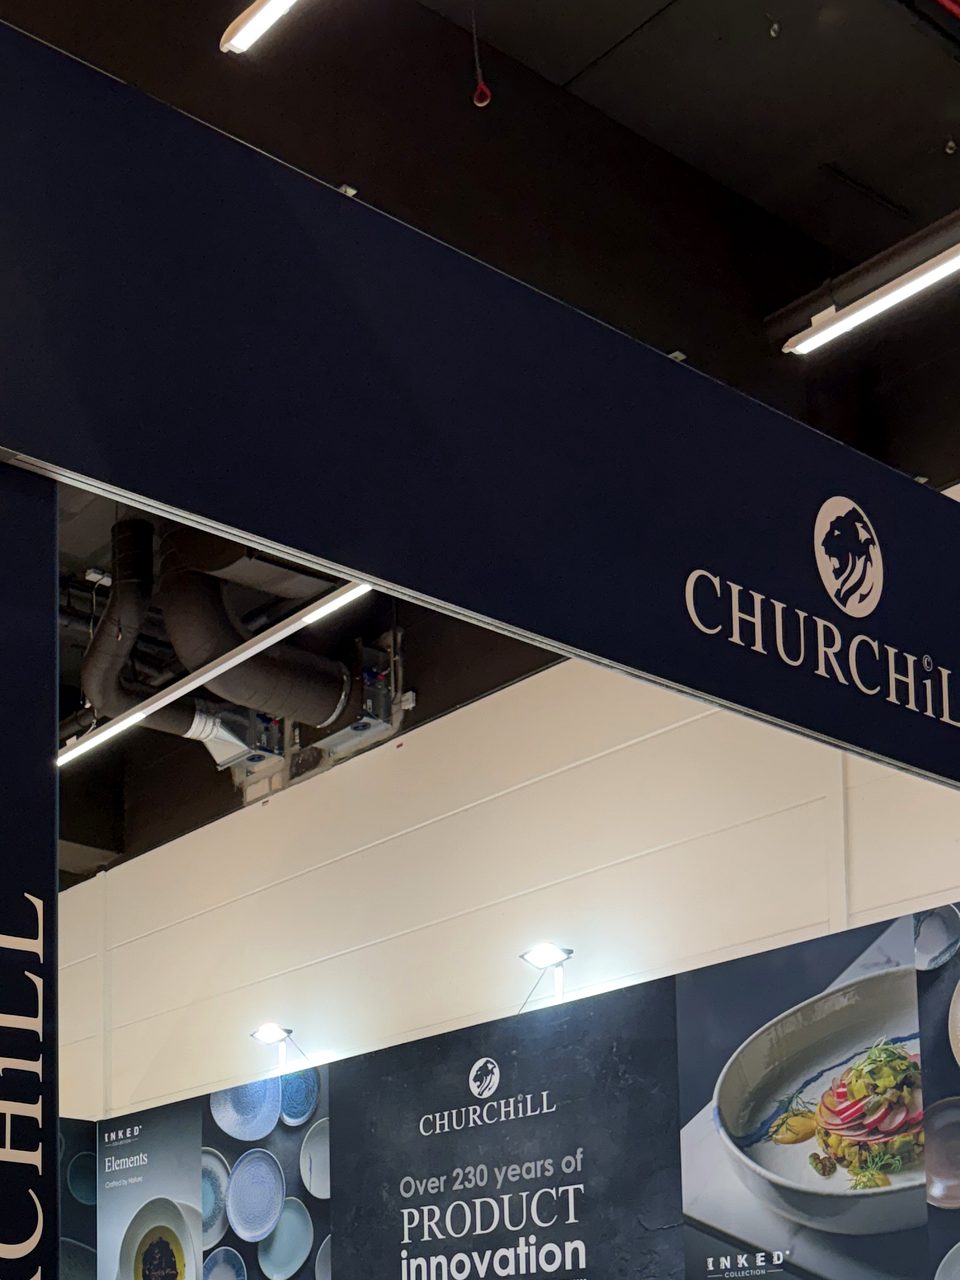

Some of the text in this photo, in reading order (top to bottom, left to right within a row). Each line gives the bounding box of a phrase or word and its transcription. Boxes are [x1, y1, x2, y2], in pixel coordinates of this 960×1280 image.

[104, 1152, 148, 1172] Elements
[399, 1148, 584, 1198] Over 230 years of
[400, 1183, 586, 1244] PRODUCT
[724, 1269, 766, 1278] COLLECTION
